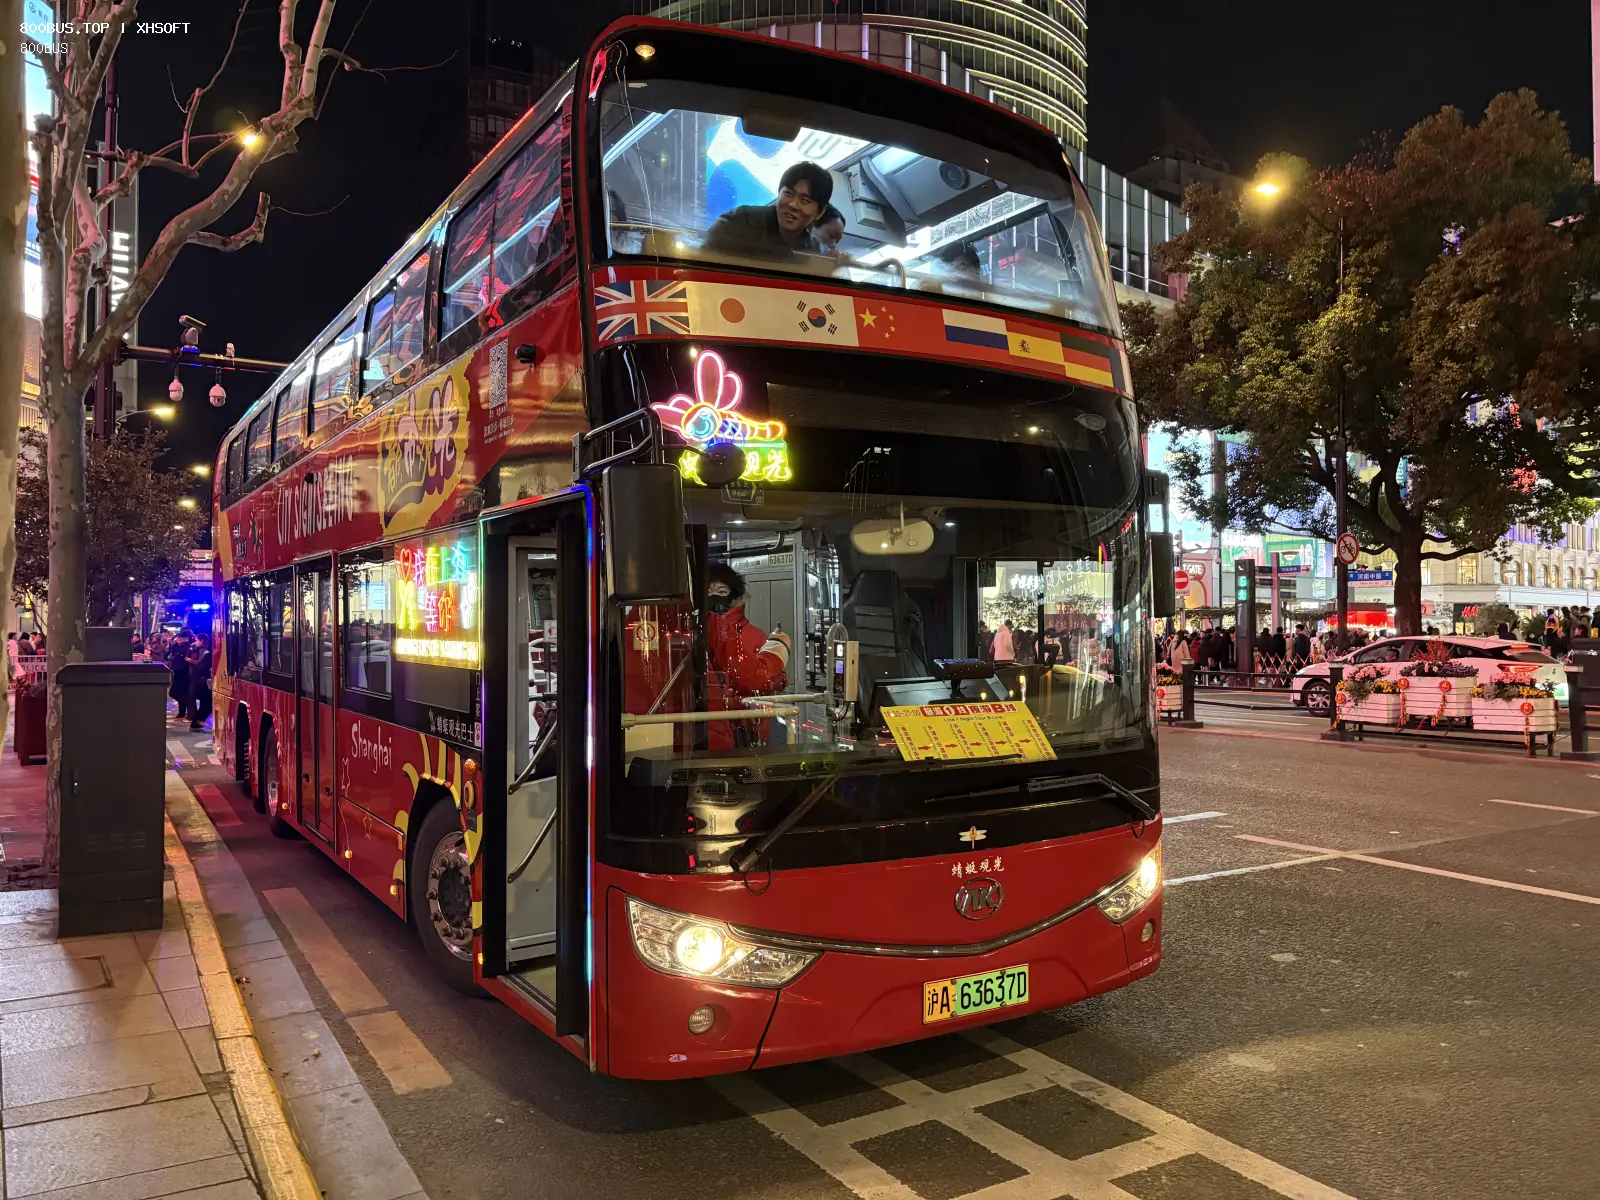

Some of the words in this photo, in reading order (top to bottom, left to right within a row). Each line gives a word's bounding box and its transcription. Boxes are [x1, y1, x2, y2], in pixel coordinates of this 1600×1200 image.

[276, 487, 293, 545] CITY
[294, 454, 354, 541] SIGHTSEEING
[351, 719, 392, 774] Shanghai
[951, 855, 1005, 879] 蜻蜓观光
